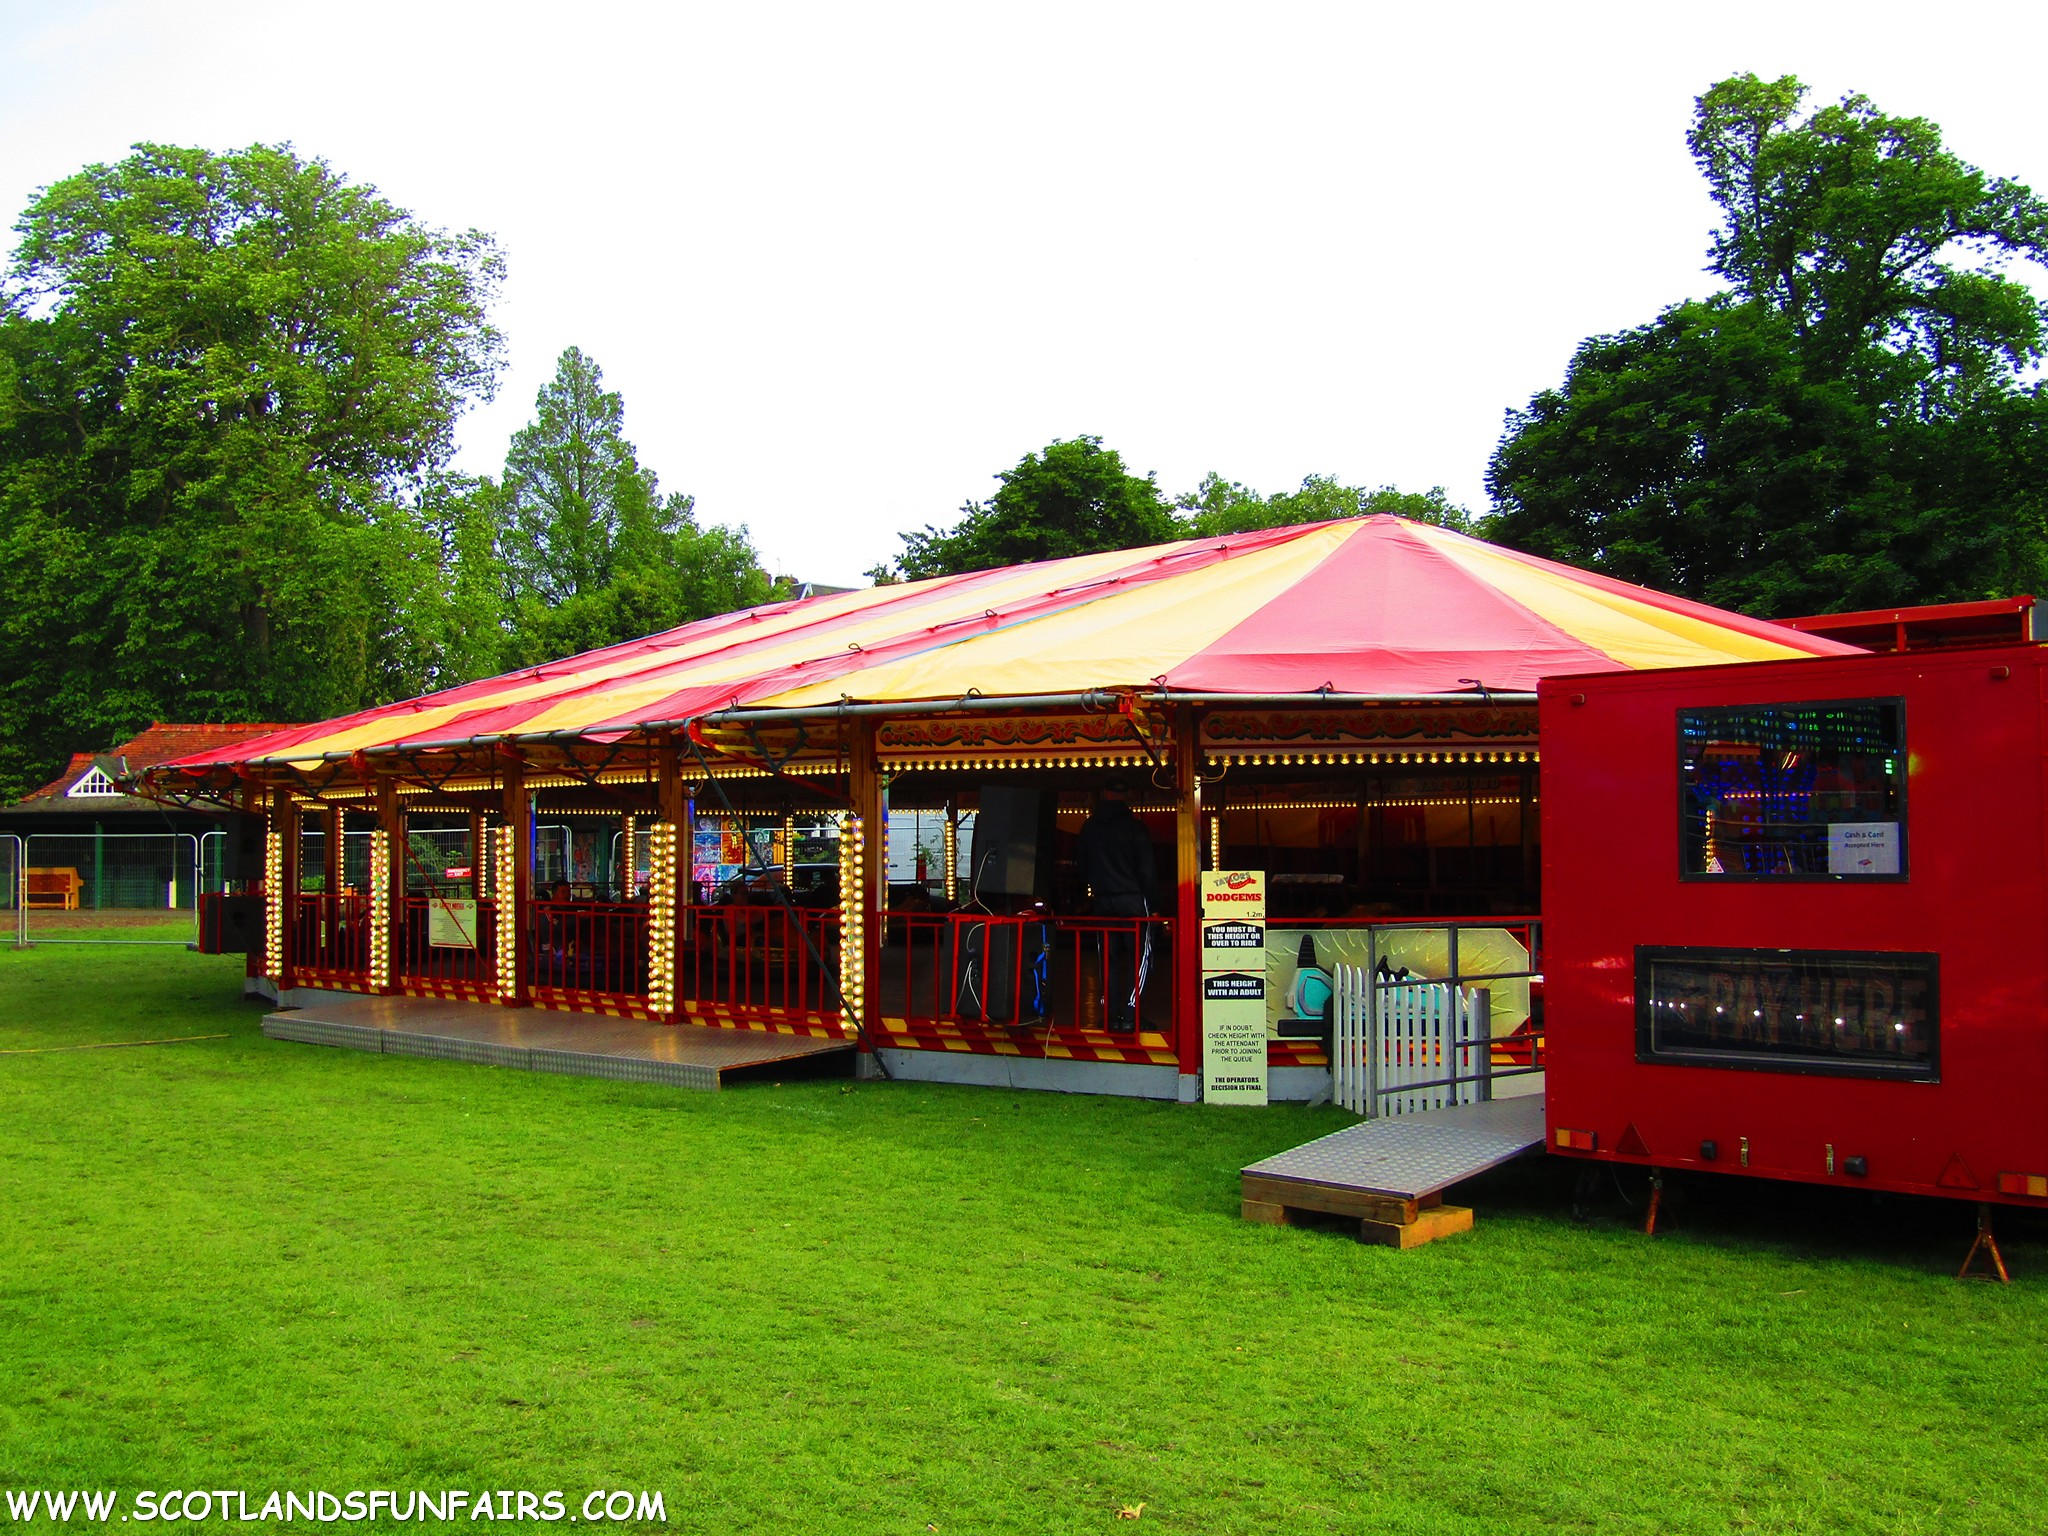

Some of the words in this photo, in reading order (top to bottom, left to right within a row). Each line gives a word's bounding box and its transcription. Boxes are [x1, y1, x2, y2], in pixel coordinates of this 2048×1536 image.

[1213, 872, 1251, 887] TAYLORS
[1206, 893, 1262, 902] DODGEMS
[1228, 988, 1239, 996] AN
[1239, 988, 1262, 996] ADULT
[1709, 973, 1788, 1045] PAY
[1800, 976, 1928, 1053] HERE
